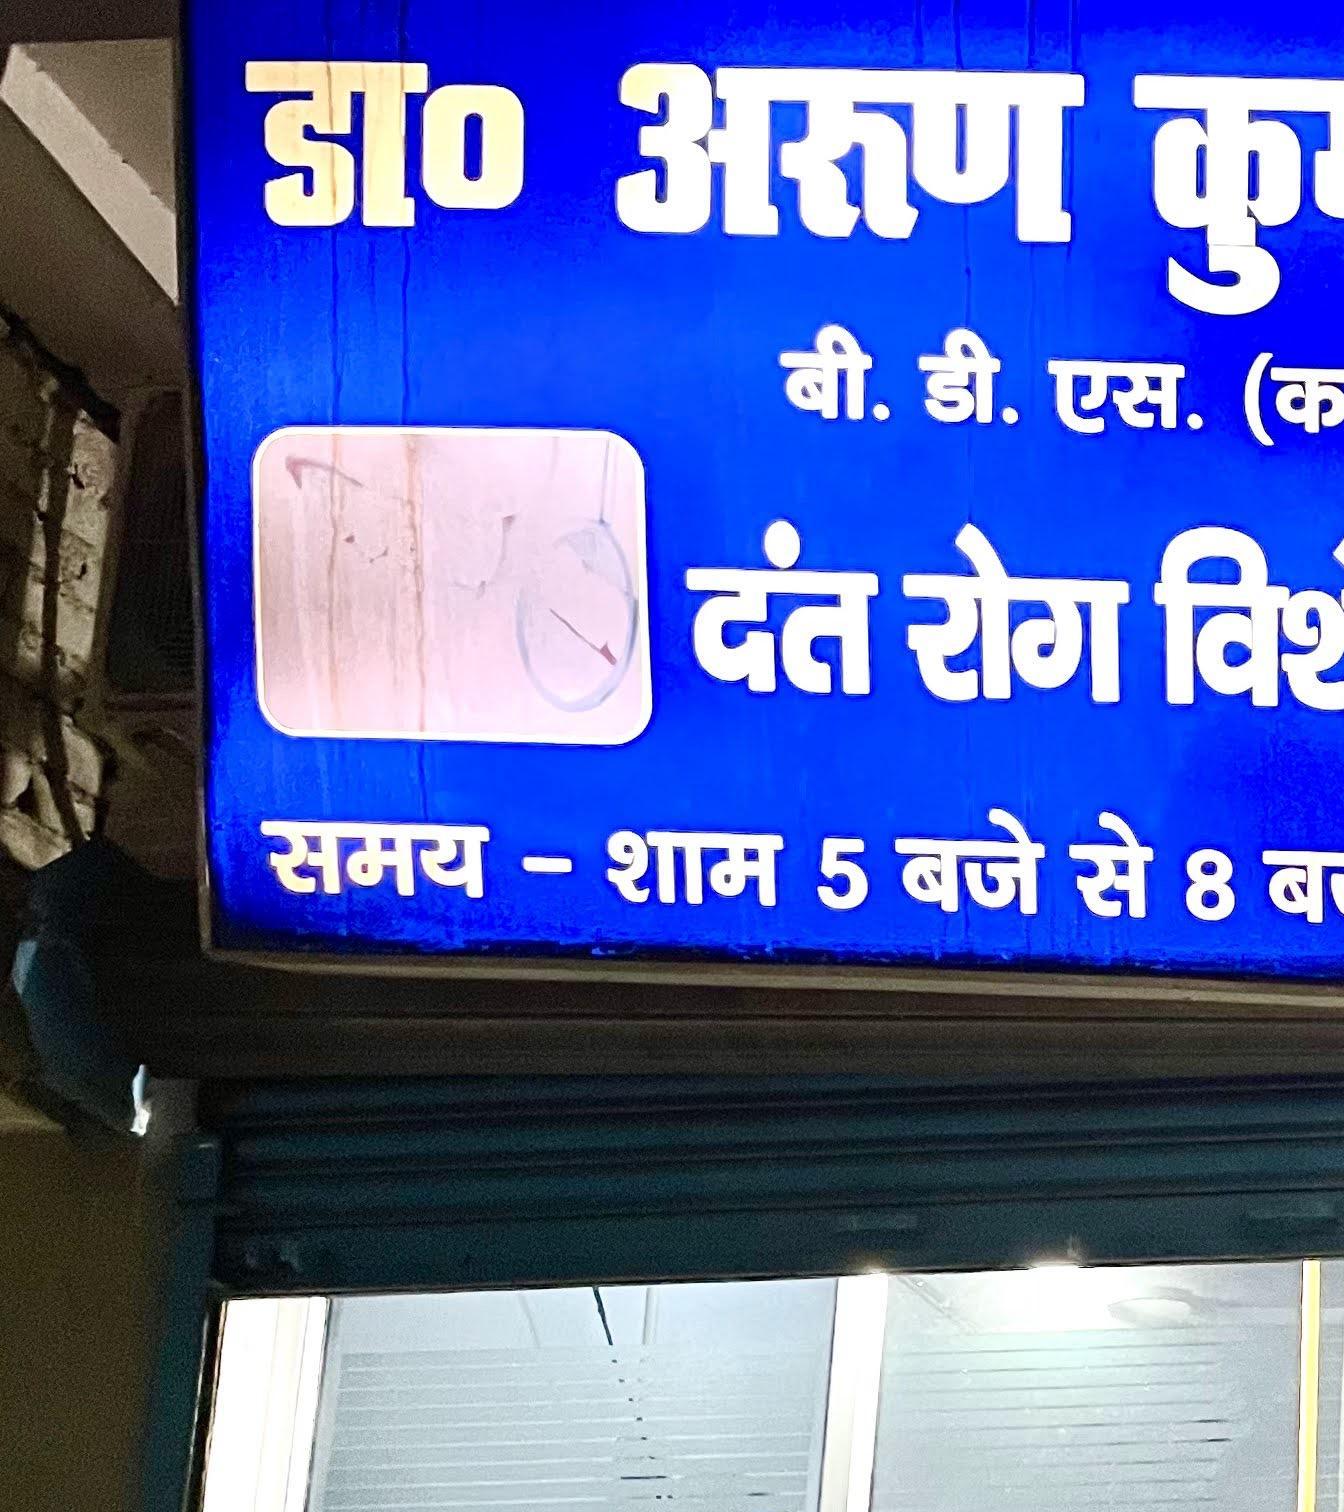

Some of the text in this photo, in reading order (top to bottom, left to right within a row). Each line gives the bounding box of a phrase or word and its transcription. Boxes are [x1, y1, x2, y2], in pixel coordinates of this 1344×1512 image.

[686, 520, 879, 695] दंत
[902, 523, 1130, 703] रोग
[260, 820, 490, 899] समय
[607, 830, 784, 907] शाम
[817, 837, 869, 910] 5
[894, 808, 1046, 915] बजे
[1068, 811, 1154, 919] से
[1185, 848, 1235, 921] 8
